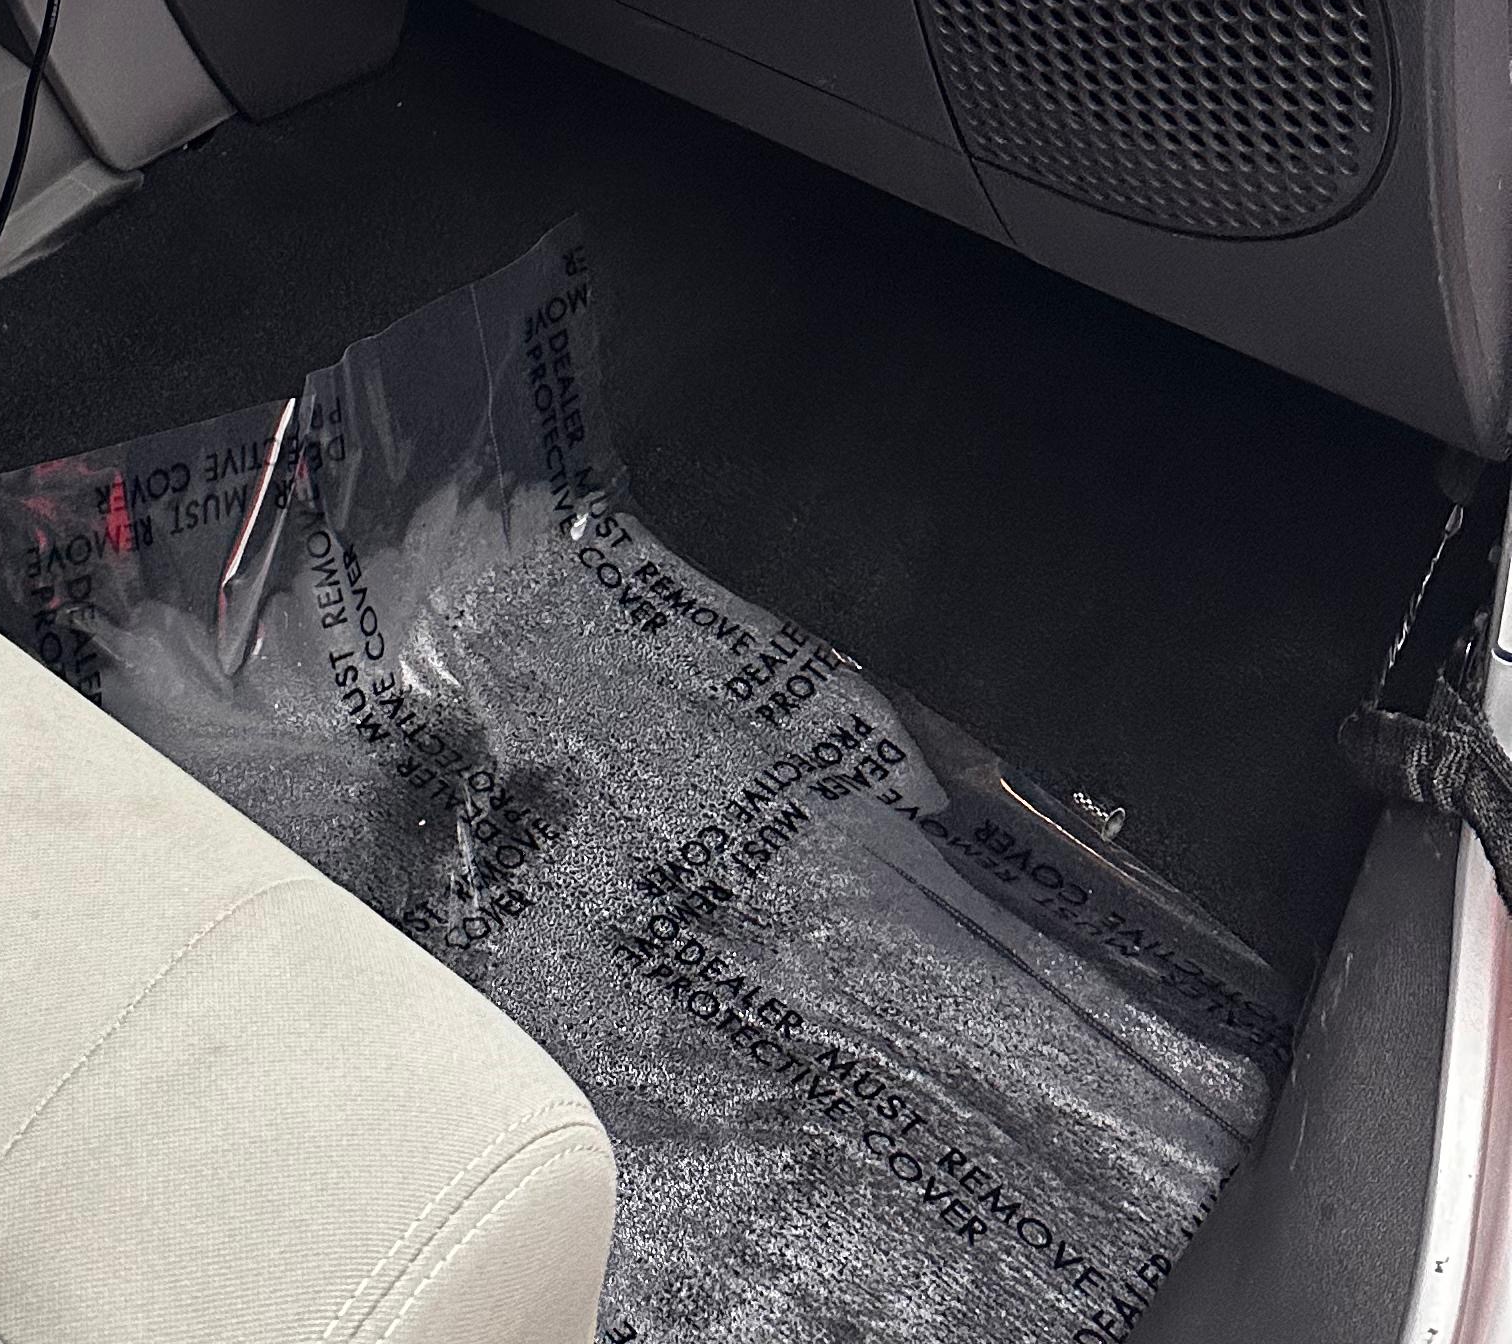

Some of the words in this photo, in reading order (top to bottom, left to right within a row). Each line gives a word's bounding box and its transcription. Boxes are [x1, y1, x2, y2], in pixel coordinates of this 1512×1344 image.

[170, 483, 249, 536] MUST
[526, 343, 578, 536] PROTECTIVE
[578, 546, 668, 636] COVER
[548, 328, 586, 448] DEALER
[634, 560, 757, 657] REMOVE
[341, 542, 386, 661] COVER
[329, 650, 391, 743] MUST
[635, 825, 729, 900] COVER
[731, 801, 809, 879] MUST
[974, 819, 1088, 905] COVER
[642, 964, 854, 1123] PROTECTIVE
[861, 1129, 988, 1247] COVER
[675, 937, 804, 1039] DEALER
[816, 1046, 928, 1136] MUST
[937, 1147, 1106, 1297] REMOVE
